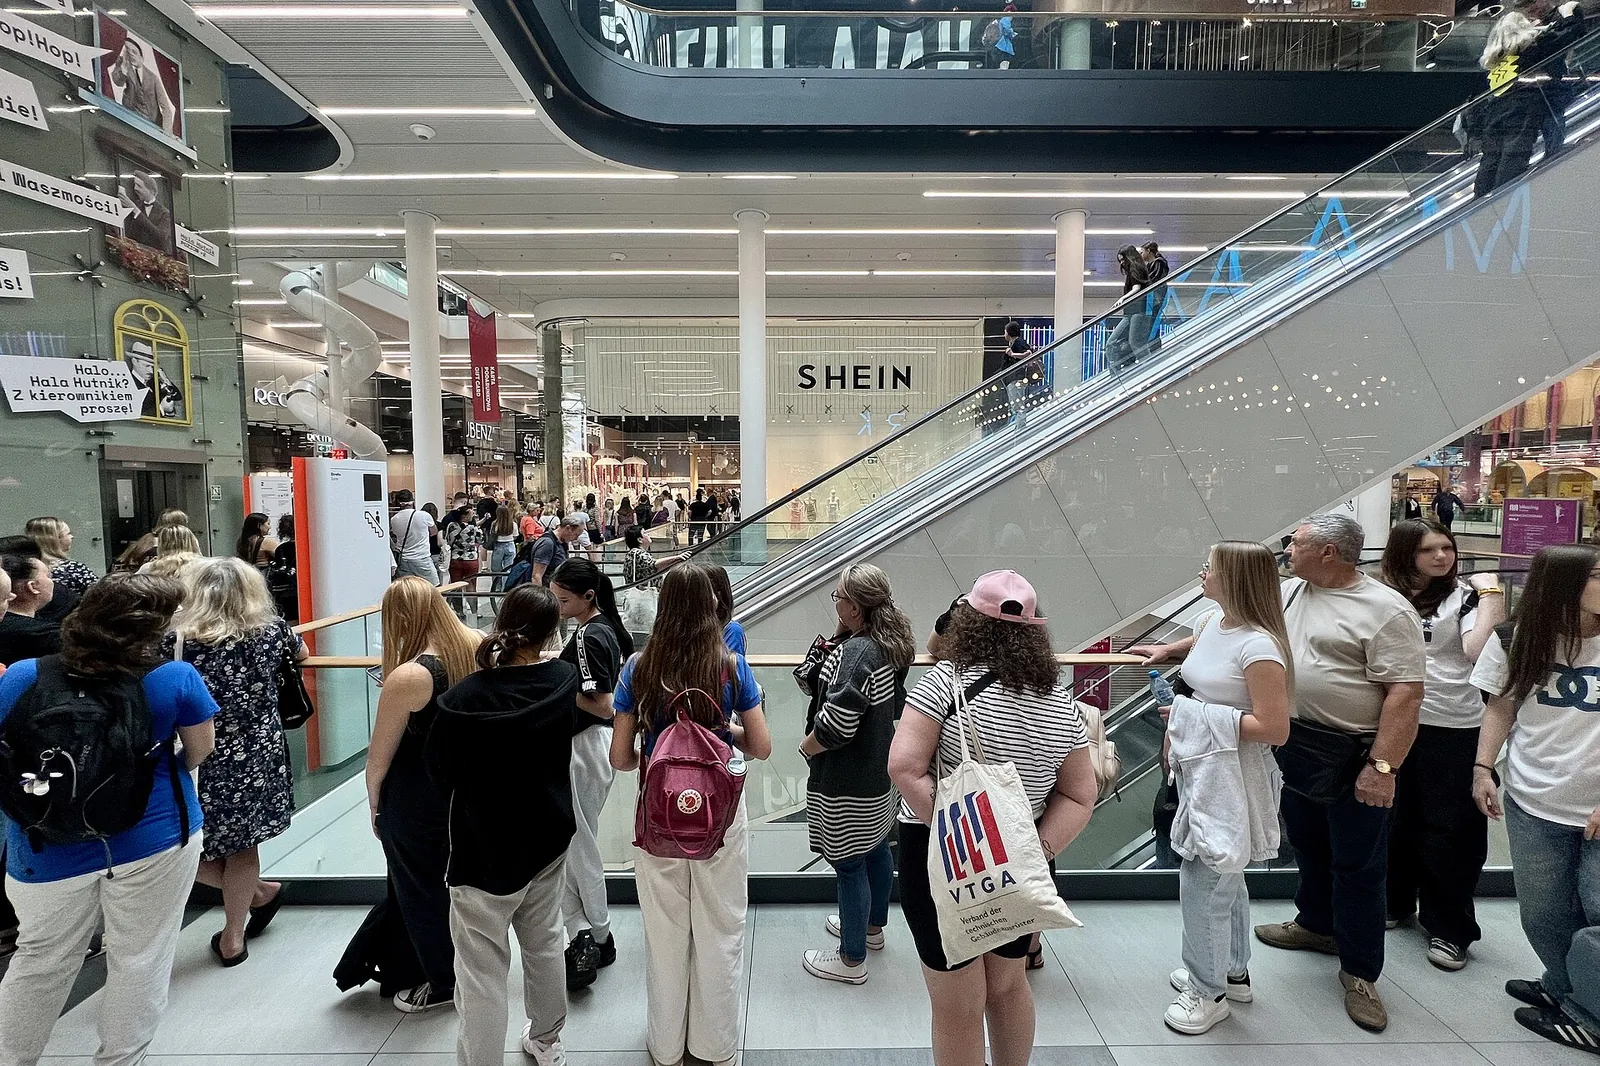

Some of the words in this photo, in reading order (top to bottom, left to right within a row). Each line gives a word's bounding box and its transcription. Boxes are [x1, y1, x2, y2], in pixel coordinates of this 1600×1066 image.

[0, 20, 80, 67] op!Hop!
[12, 171, 119, 216] Waszmości!
[74, 364, 126, 377] Halo...
[797, 364, 912, 389] SHEIN
[30, 376, 69, 388] Hala
[73, 377, 129, 389] Hutnik?
[12, 390, 23, 401] Z
[29, 389, 133, 401] kierownikiem
[80, 403, 133, 416] proszę!
[949, 870, 1017, 904] VTGA
[960, 910, 989, 925] Verband
[990, 907, 1002, 916] der
[965, 917, 1008, 934] technischen
